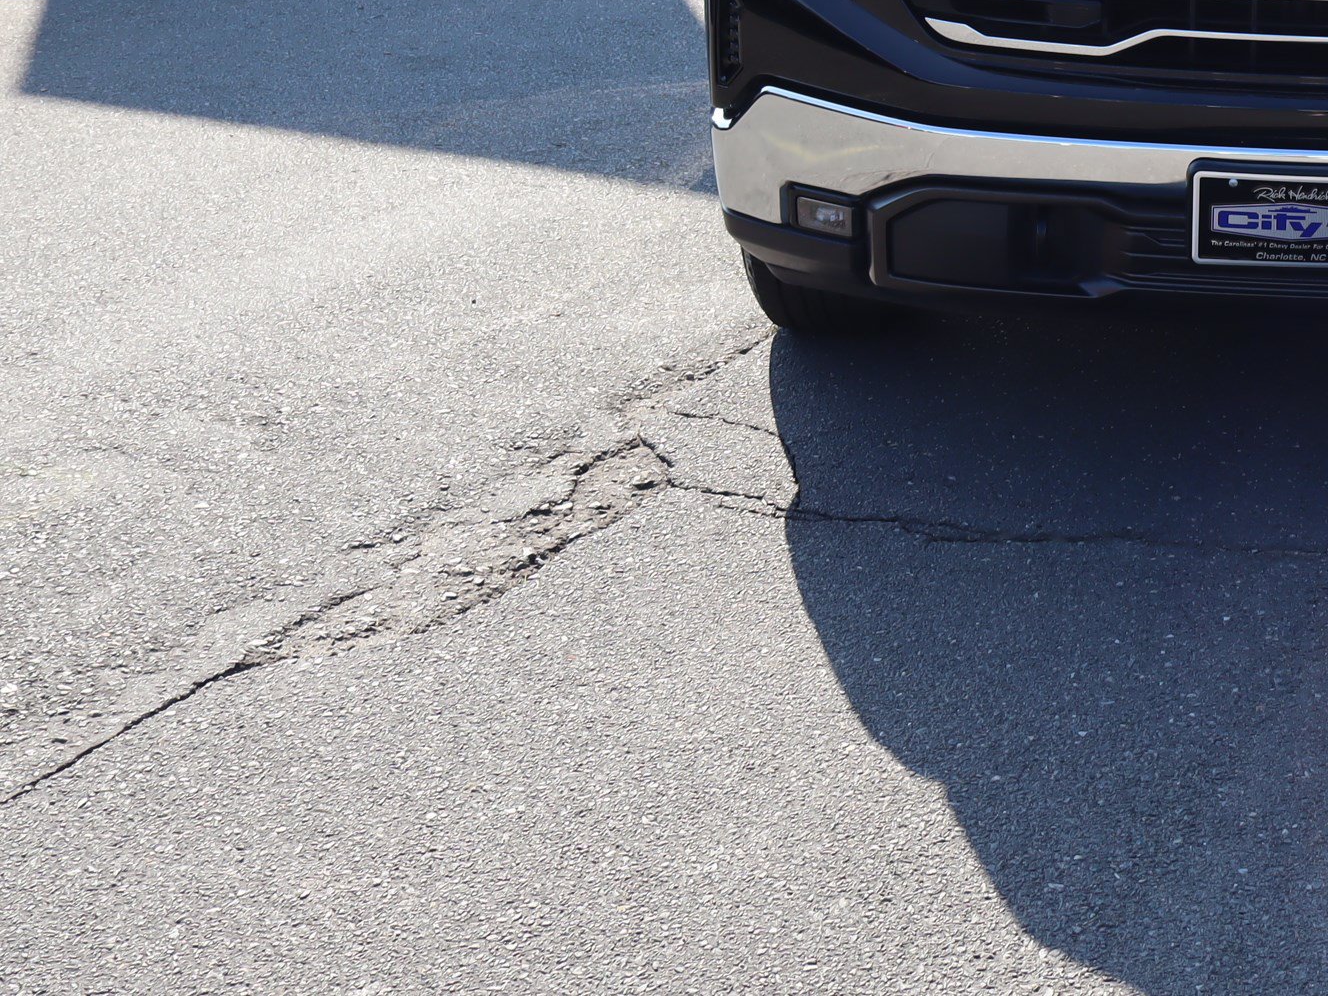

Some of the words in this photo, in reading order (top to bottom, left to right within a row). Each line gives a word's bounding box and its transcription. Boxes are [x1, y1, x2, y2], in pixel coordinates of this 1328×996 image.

[1253, 186, 1286, 202] Rick
[1217, 209, 1323, 238] City
[1269, 242, 1288, 250] Chevy
[1255, 251, 1306, 261] Charlotte,
[1310, 253, 1327, 261] NC
